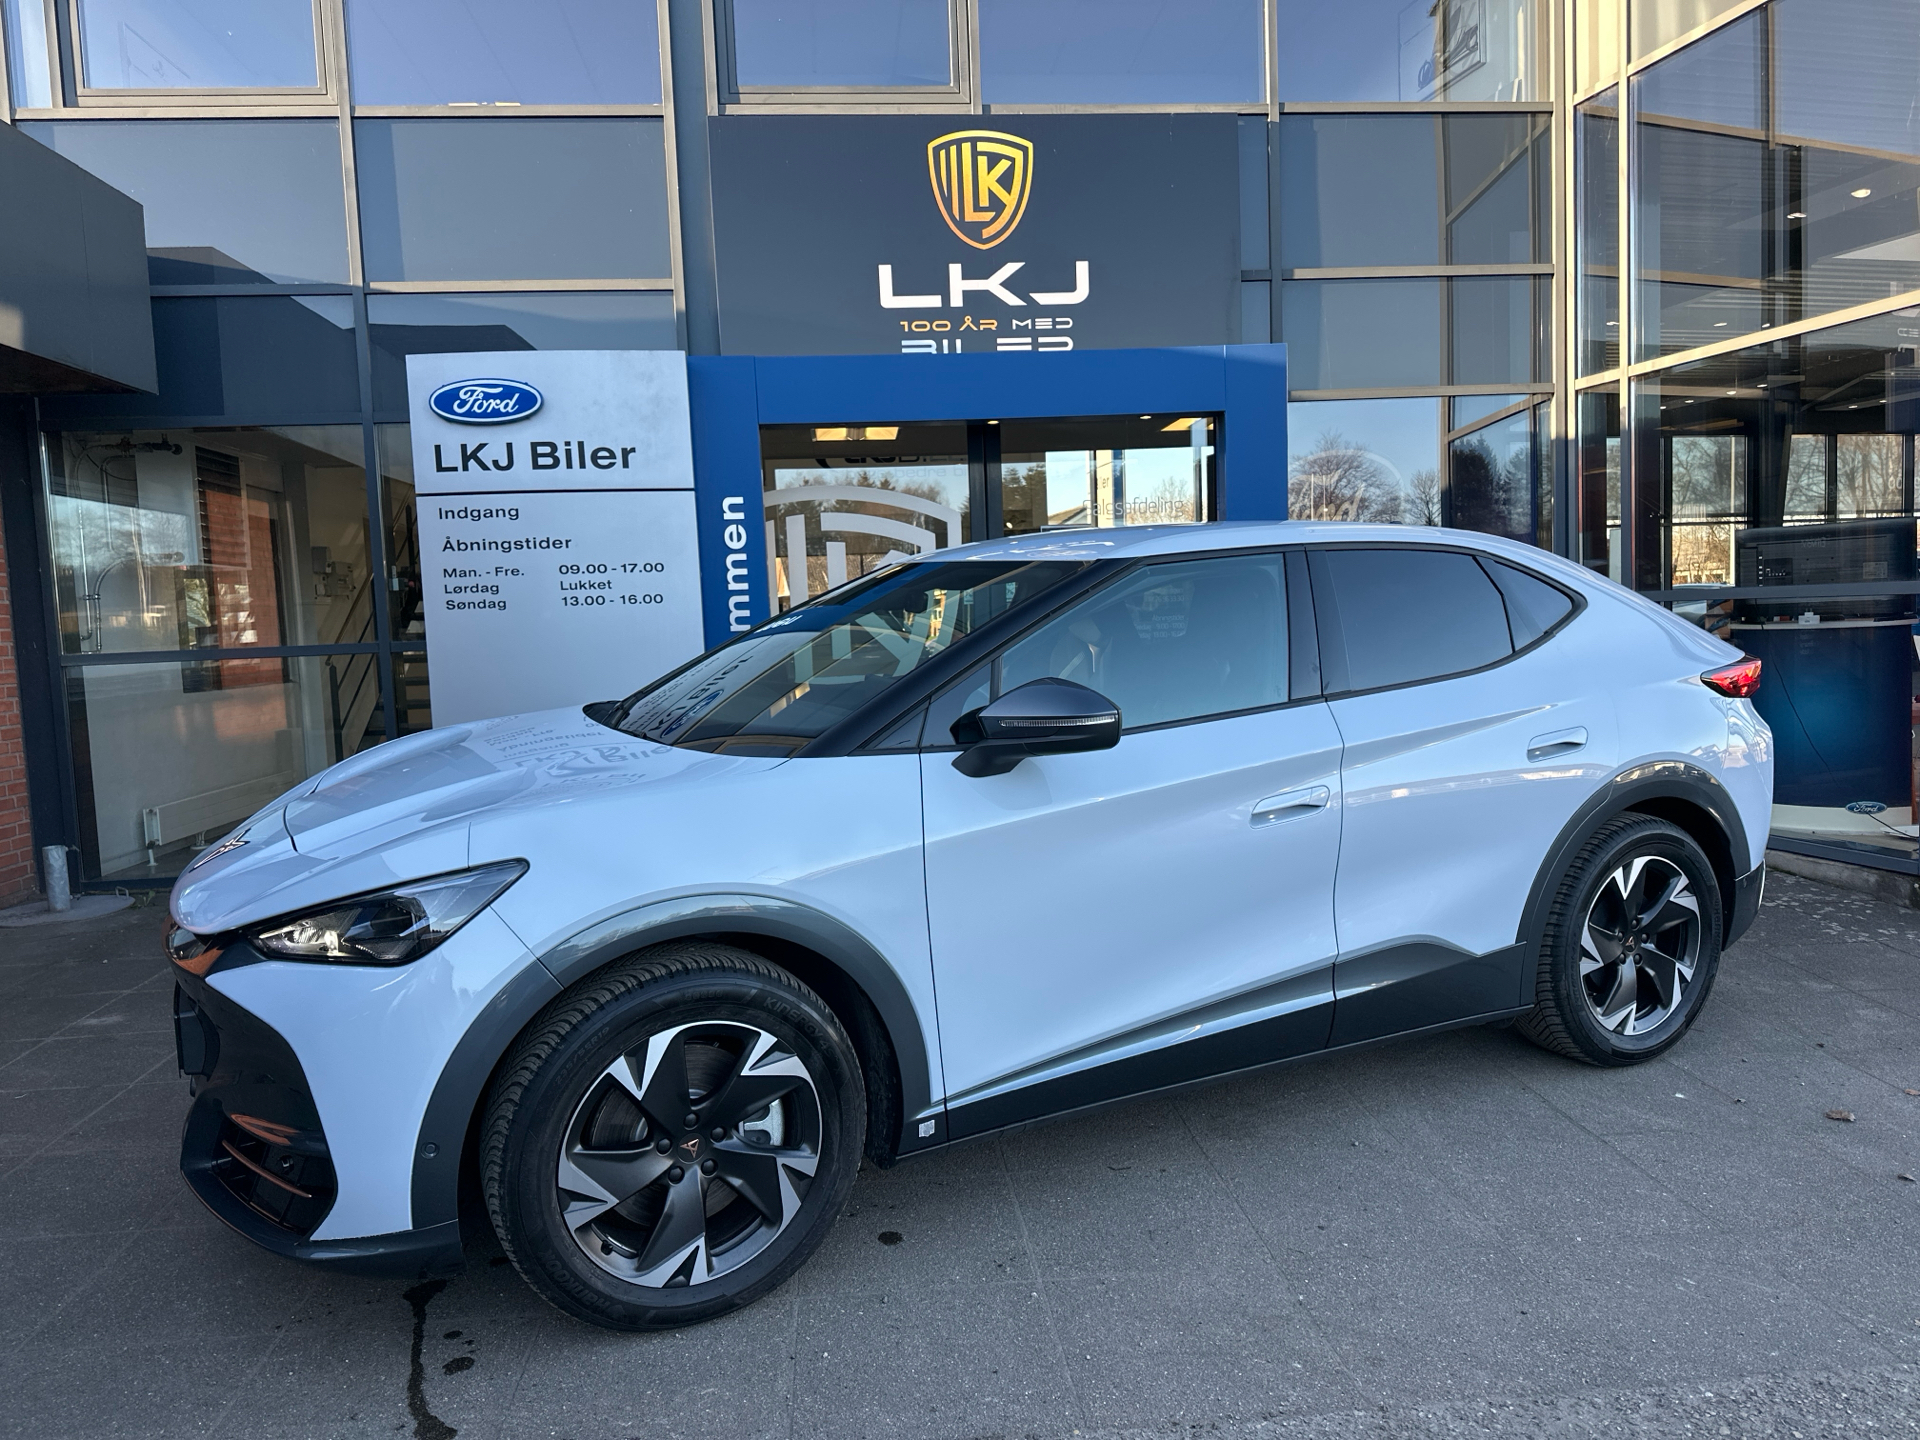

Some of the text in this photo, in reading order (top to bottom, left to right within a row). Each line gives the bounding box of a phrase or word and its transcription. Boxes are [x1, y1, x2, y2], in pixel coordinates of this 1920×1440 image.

[878, 260, 1090, 309] LKJ
[900, 315, 1074, 333] 100 ÅR MED
[452, 385, 520, 414] Ford
[433, 440, 637, 473] LKJ Biler
[438, 506, 520, 522] Indgang
[442, 535, 572, 554] Åbningstider
[443, 567, 482, 579] Man.
[494, 566, 525, 577] Fre.
[558, 563, 608, 575] 09.00
[620, 562, 665, 574] 17.00
[444, 579, 613, 595] Lørdag Lukket
[445, 598, 507, 611] Søndag
[561, 595, 606, 607] 13.00
[619, 593, 664, 605] 16.00
